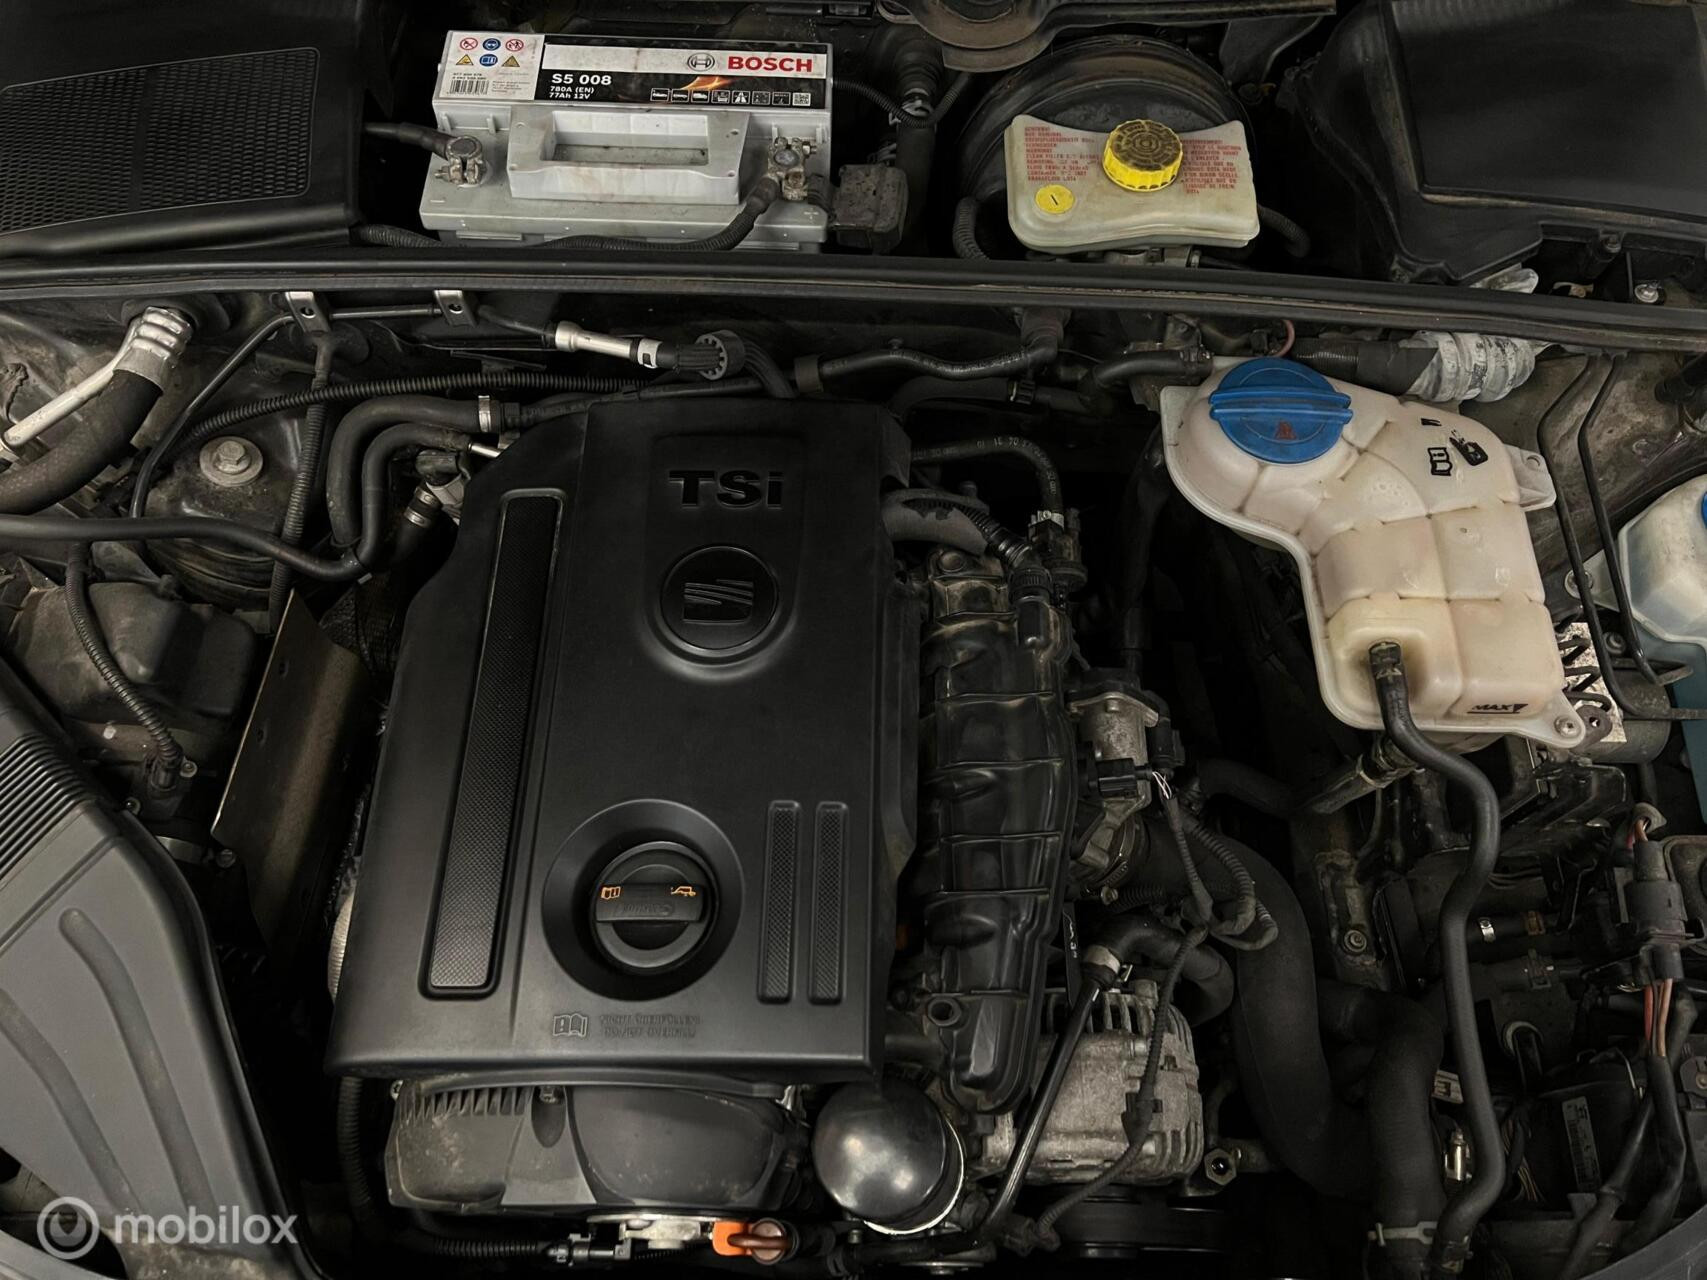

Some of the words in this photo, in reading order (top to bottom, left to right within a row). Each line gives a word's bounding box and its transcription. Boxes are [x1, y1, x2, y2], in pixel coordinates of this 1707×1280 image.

[728, 56, 813, 73] BOSCH
[551, 73, 574, 84] S5
[579, 74, 612, 86] 008
[550, 85, 573, 93] 780A
[575, 86, 595, 94] (EN)
[668, 470, 784, 509] TSi
[1471, 703, 1513, 711] MAX
